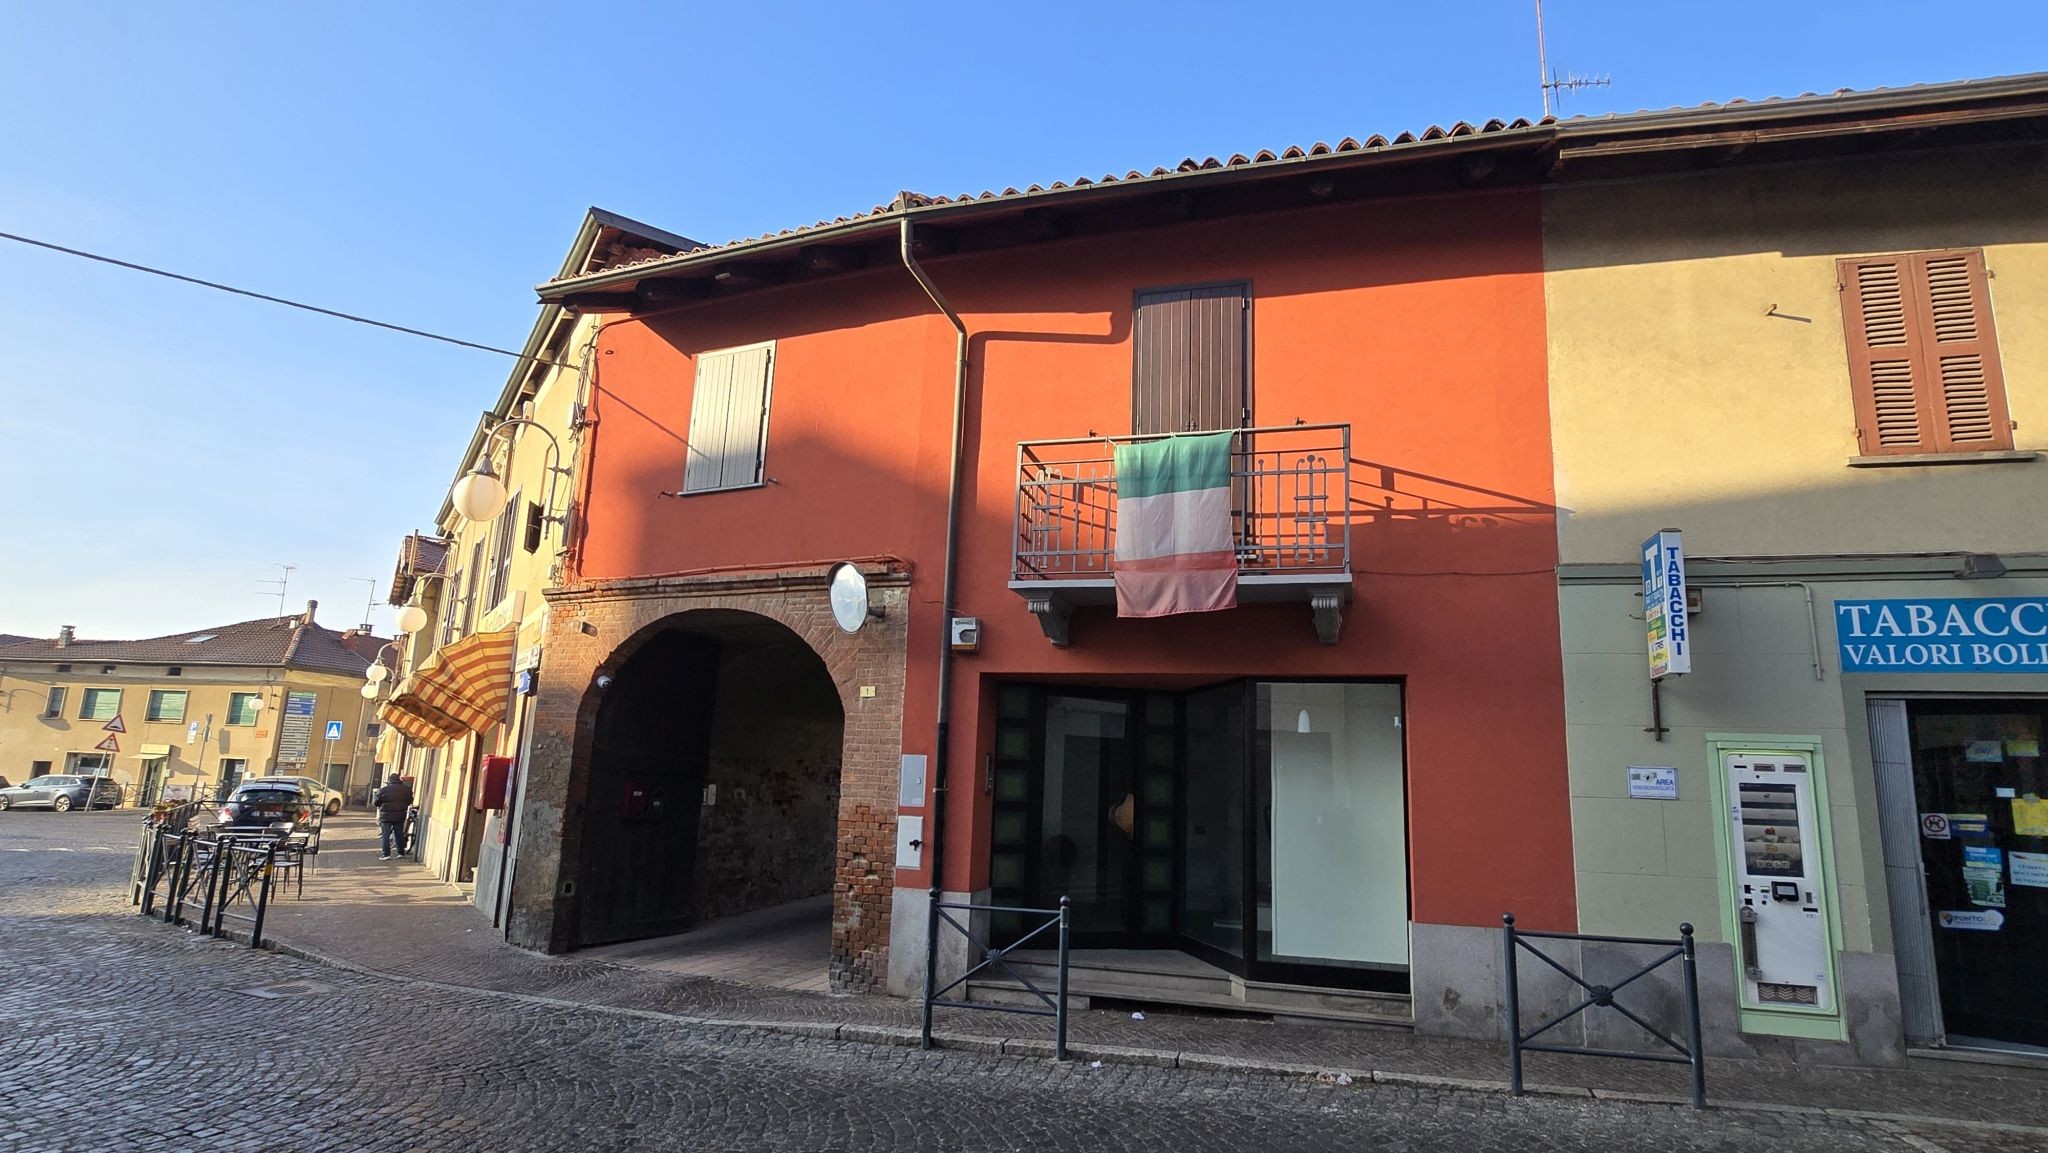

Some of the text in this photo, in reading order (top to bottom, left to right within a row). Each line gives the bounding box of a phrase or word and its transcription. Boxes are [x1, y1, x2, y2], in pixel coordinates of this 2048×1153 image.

[1666, 547, 1686, 655] TABACCHI
[1839, 602, 2048, 637] TABACC
[1843, 643, 1963, 665] VALORI
[1655, 778, 1675, 786] AREA
